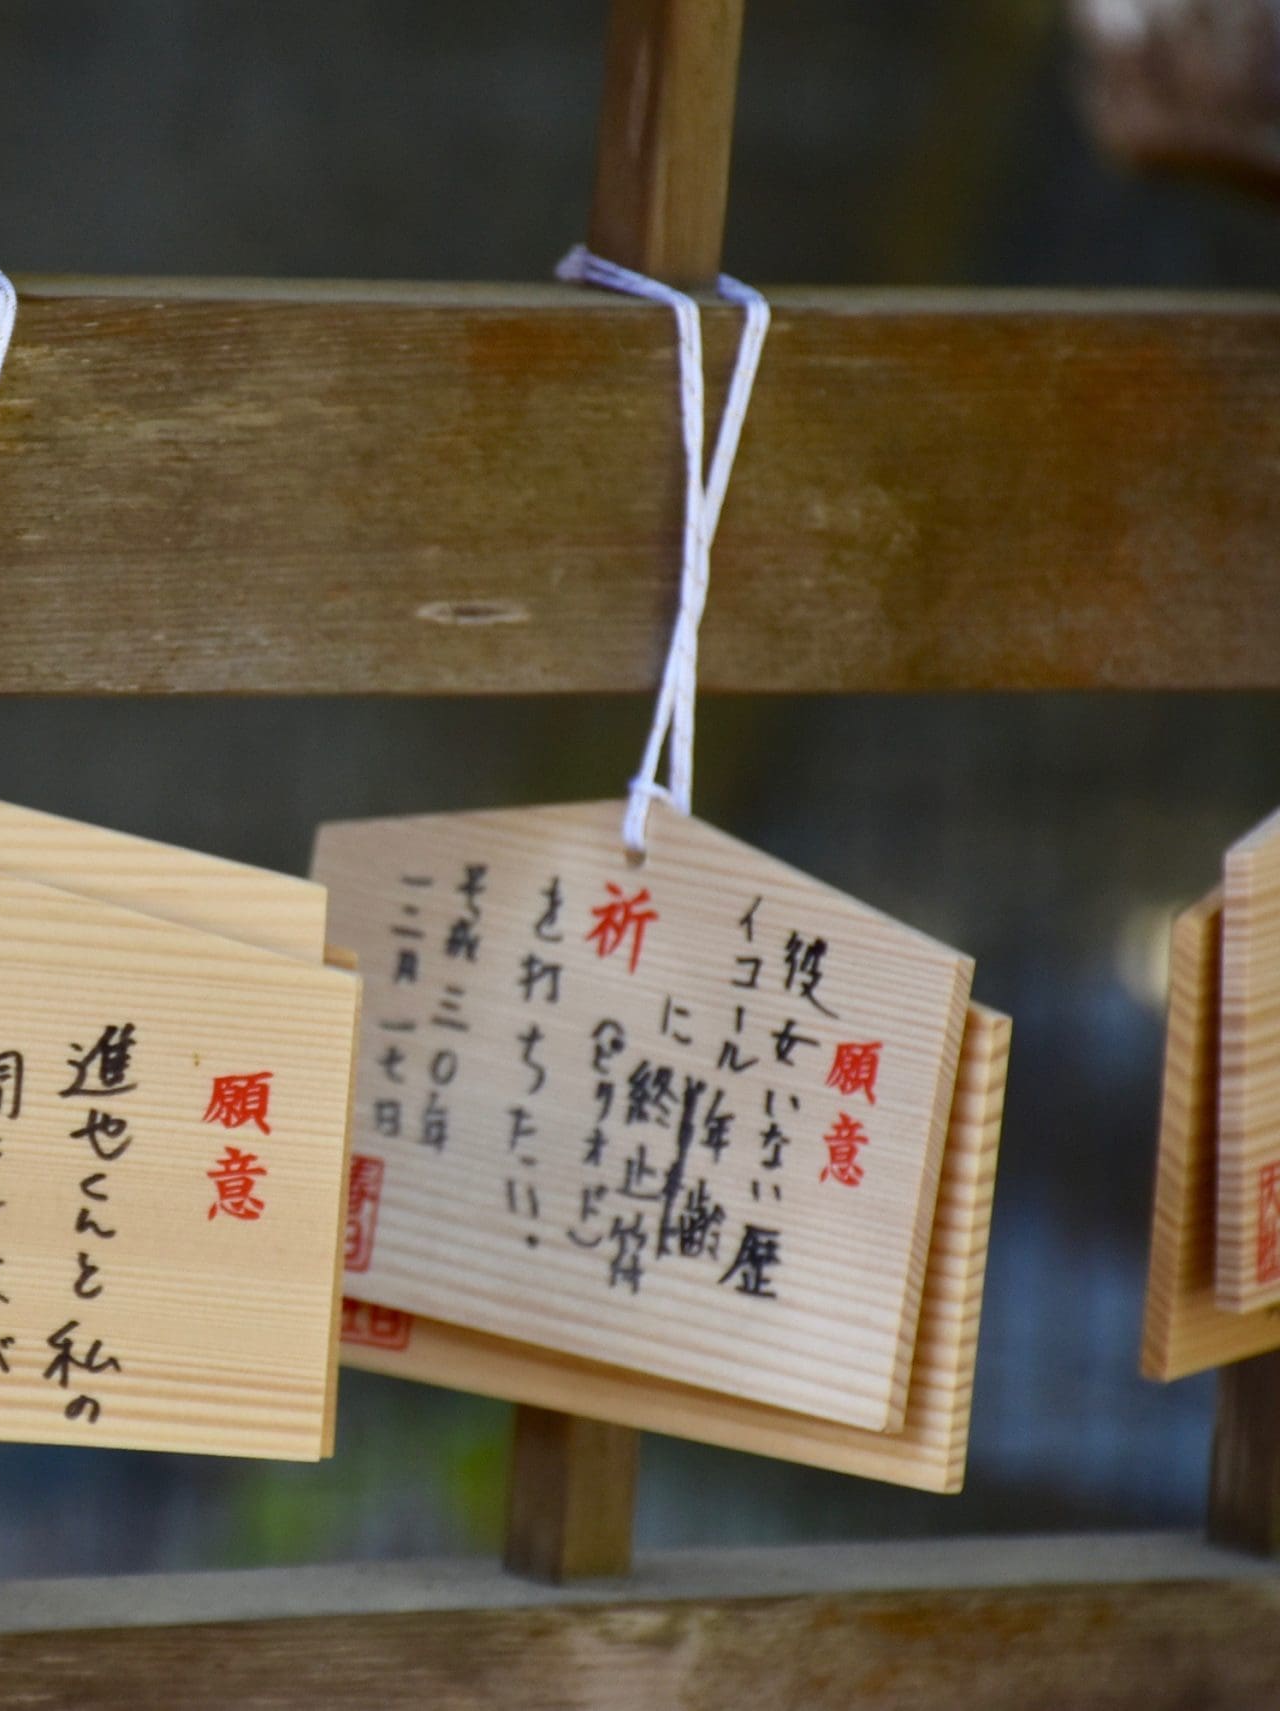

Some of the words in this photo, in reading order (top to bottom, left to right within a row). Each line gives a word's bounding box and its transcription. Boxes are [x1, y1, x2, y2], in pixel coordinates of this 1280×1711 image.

[586, 882, 658, 973] 祈
[203, 1071, 274, 1221] 願意
[818, 1041, 884, 1188] 願意
[43, 1022, 138, 1424] 進也くんと私の
